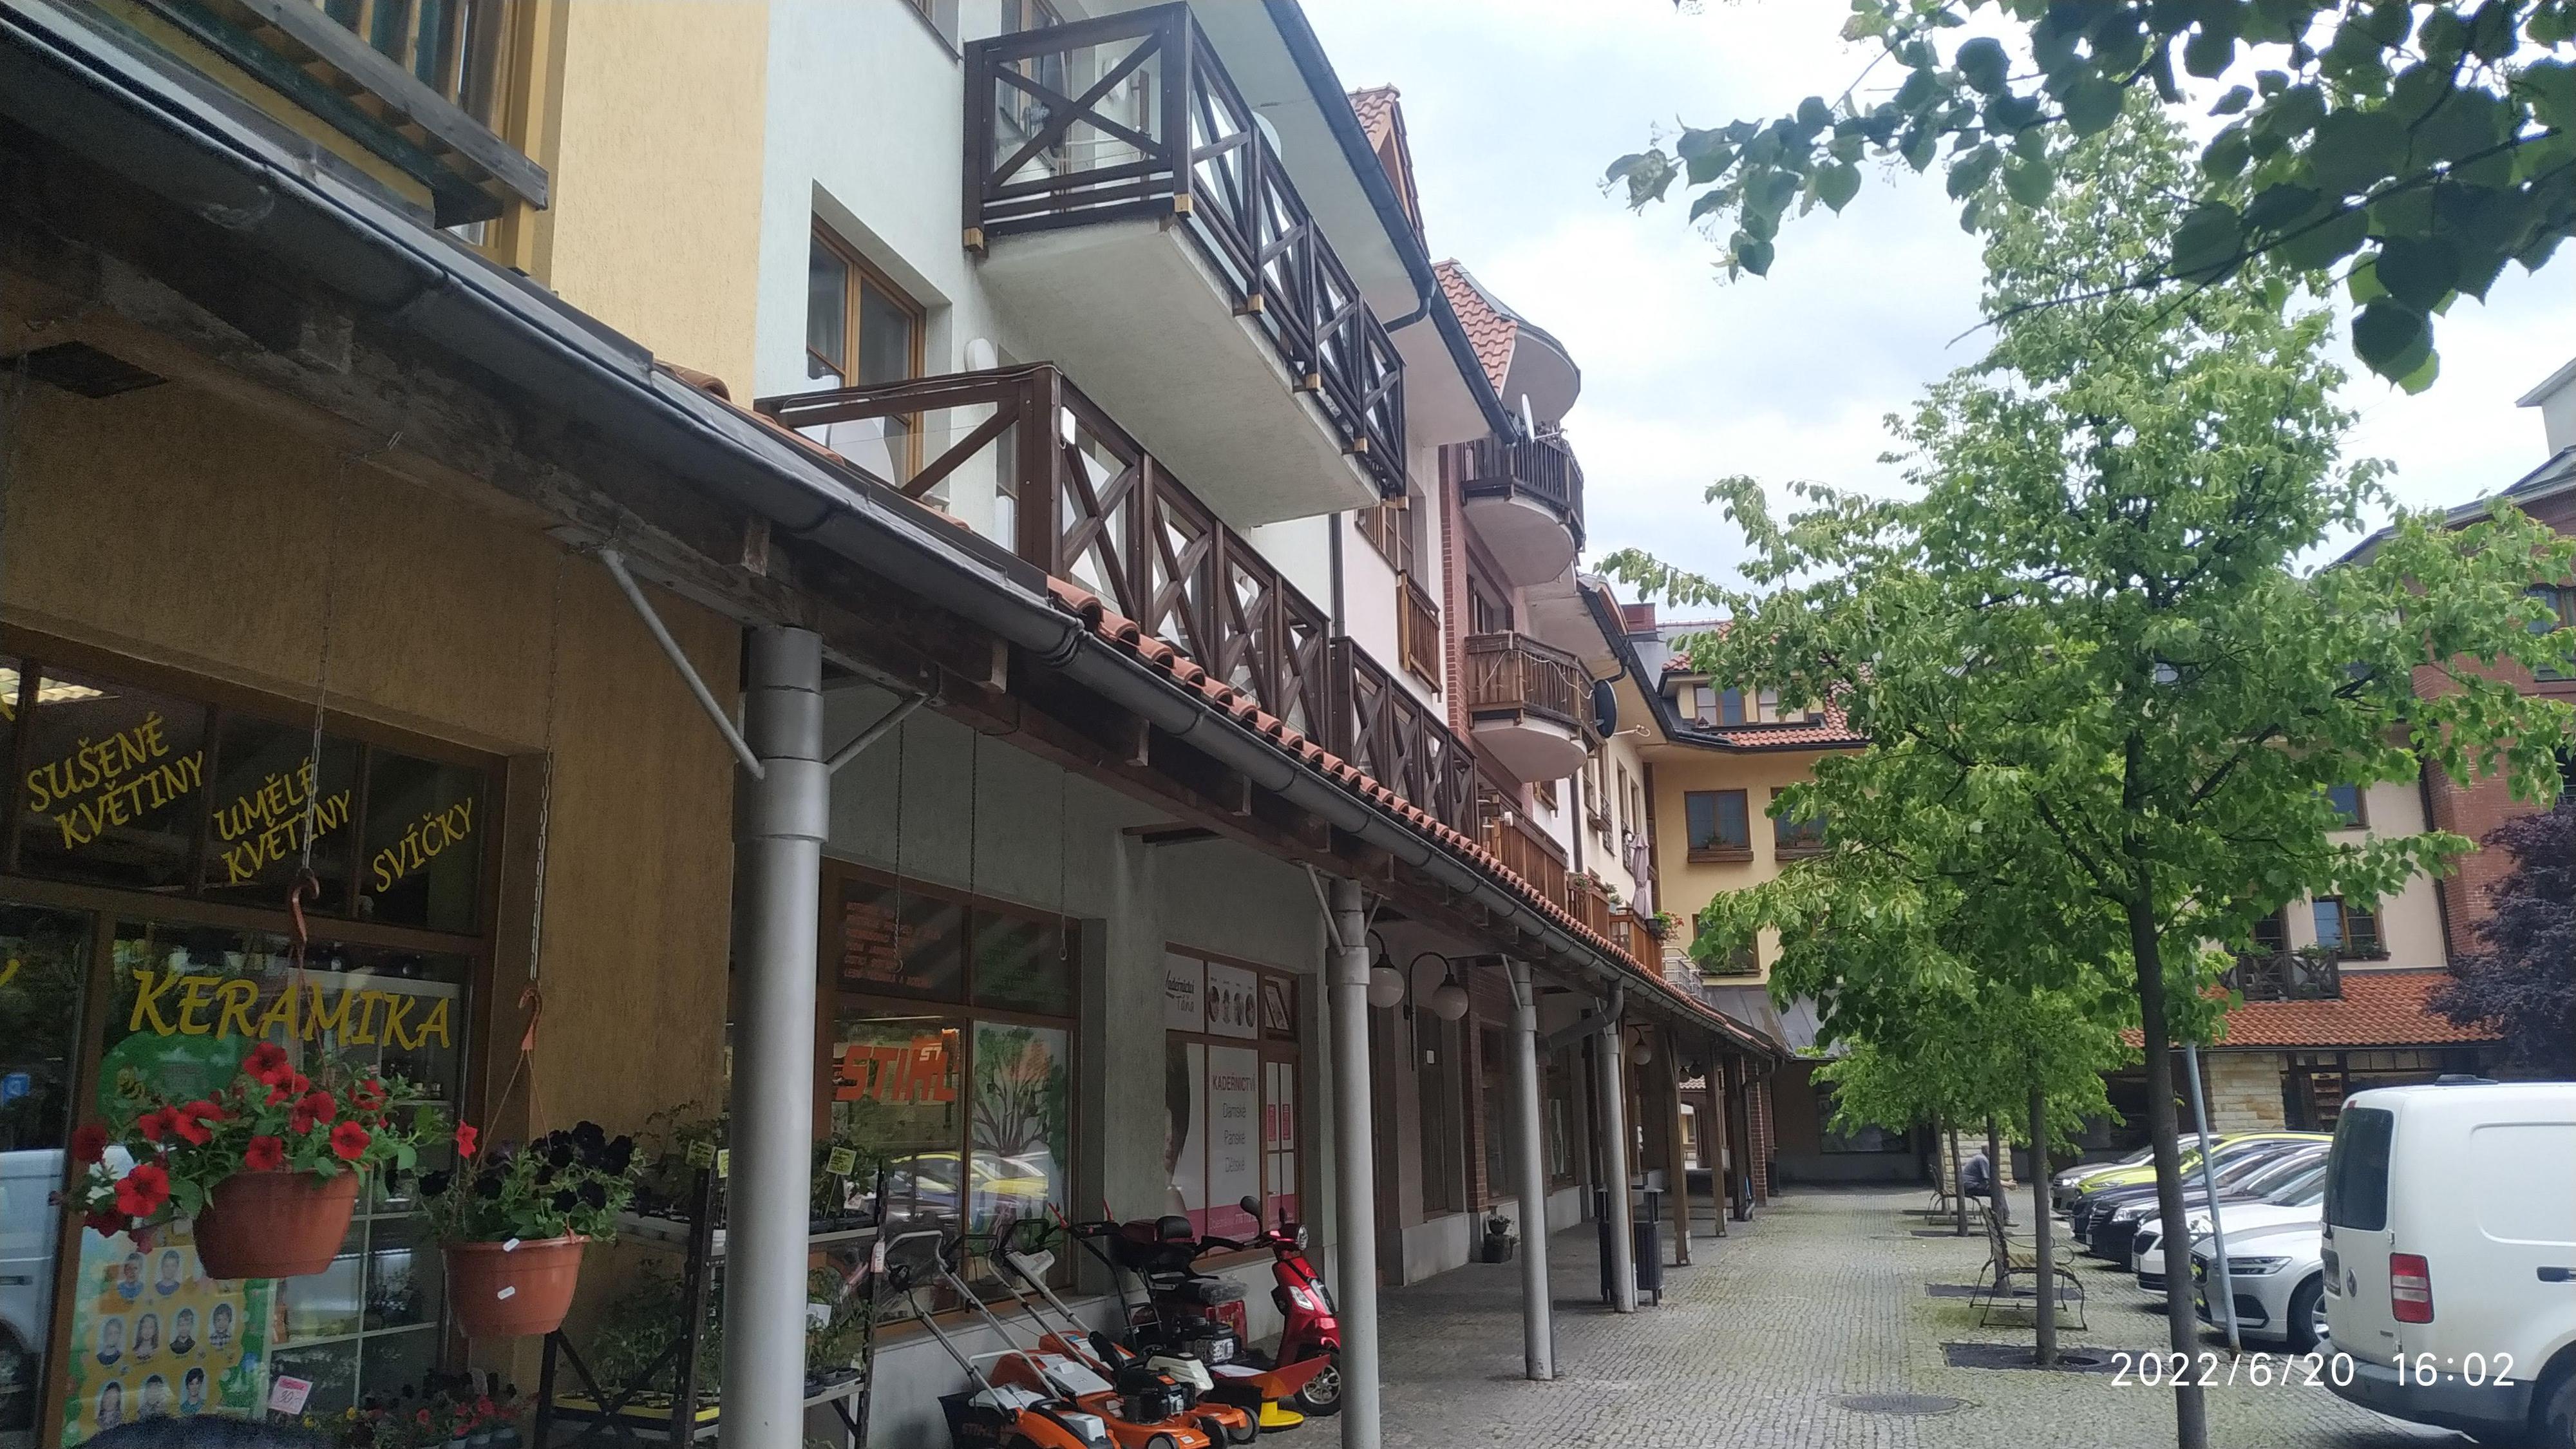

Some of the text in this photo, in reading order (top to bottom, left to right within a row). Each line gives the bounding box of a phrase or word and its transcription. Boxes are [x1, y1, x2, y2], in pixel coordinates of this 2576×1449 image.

[27, 712, 169, 812] SUŠENÉ
[53, 750, 204, 849] KVĚTINY
[213, 757, 319, 840] UMĚLÉ
[373, 797, 472, 893] SVÍČKY
[128, 969, 451, 1050] KERAMIKA
[835, 1045, 957, 1102] STIHL
